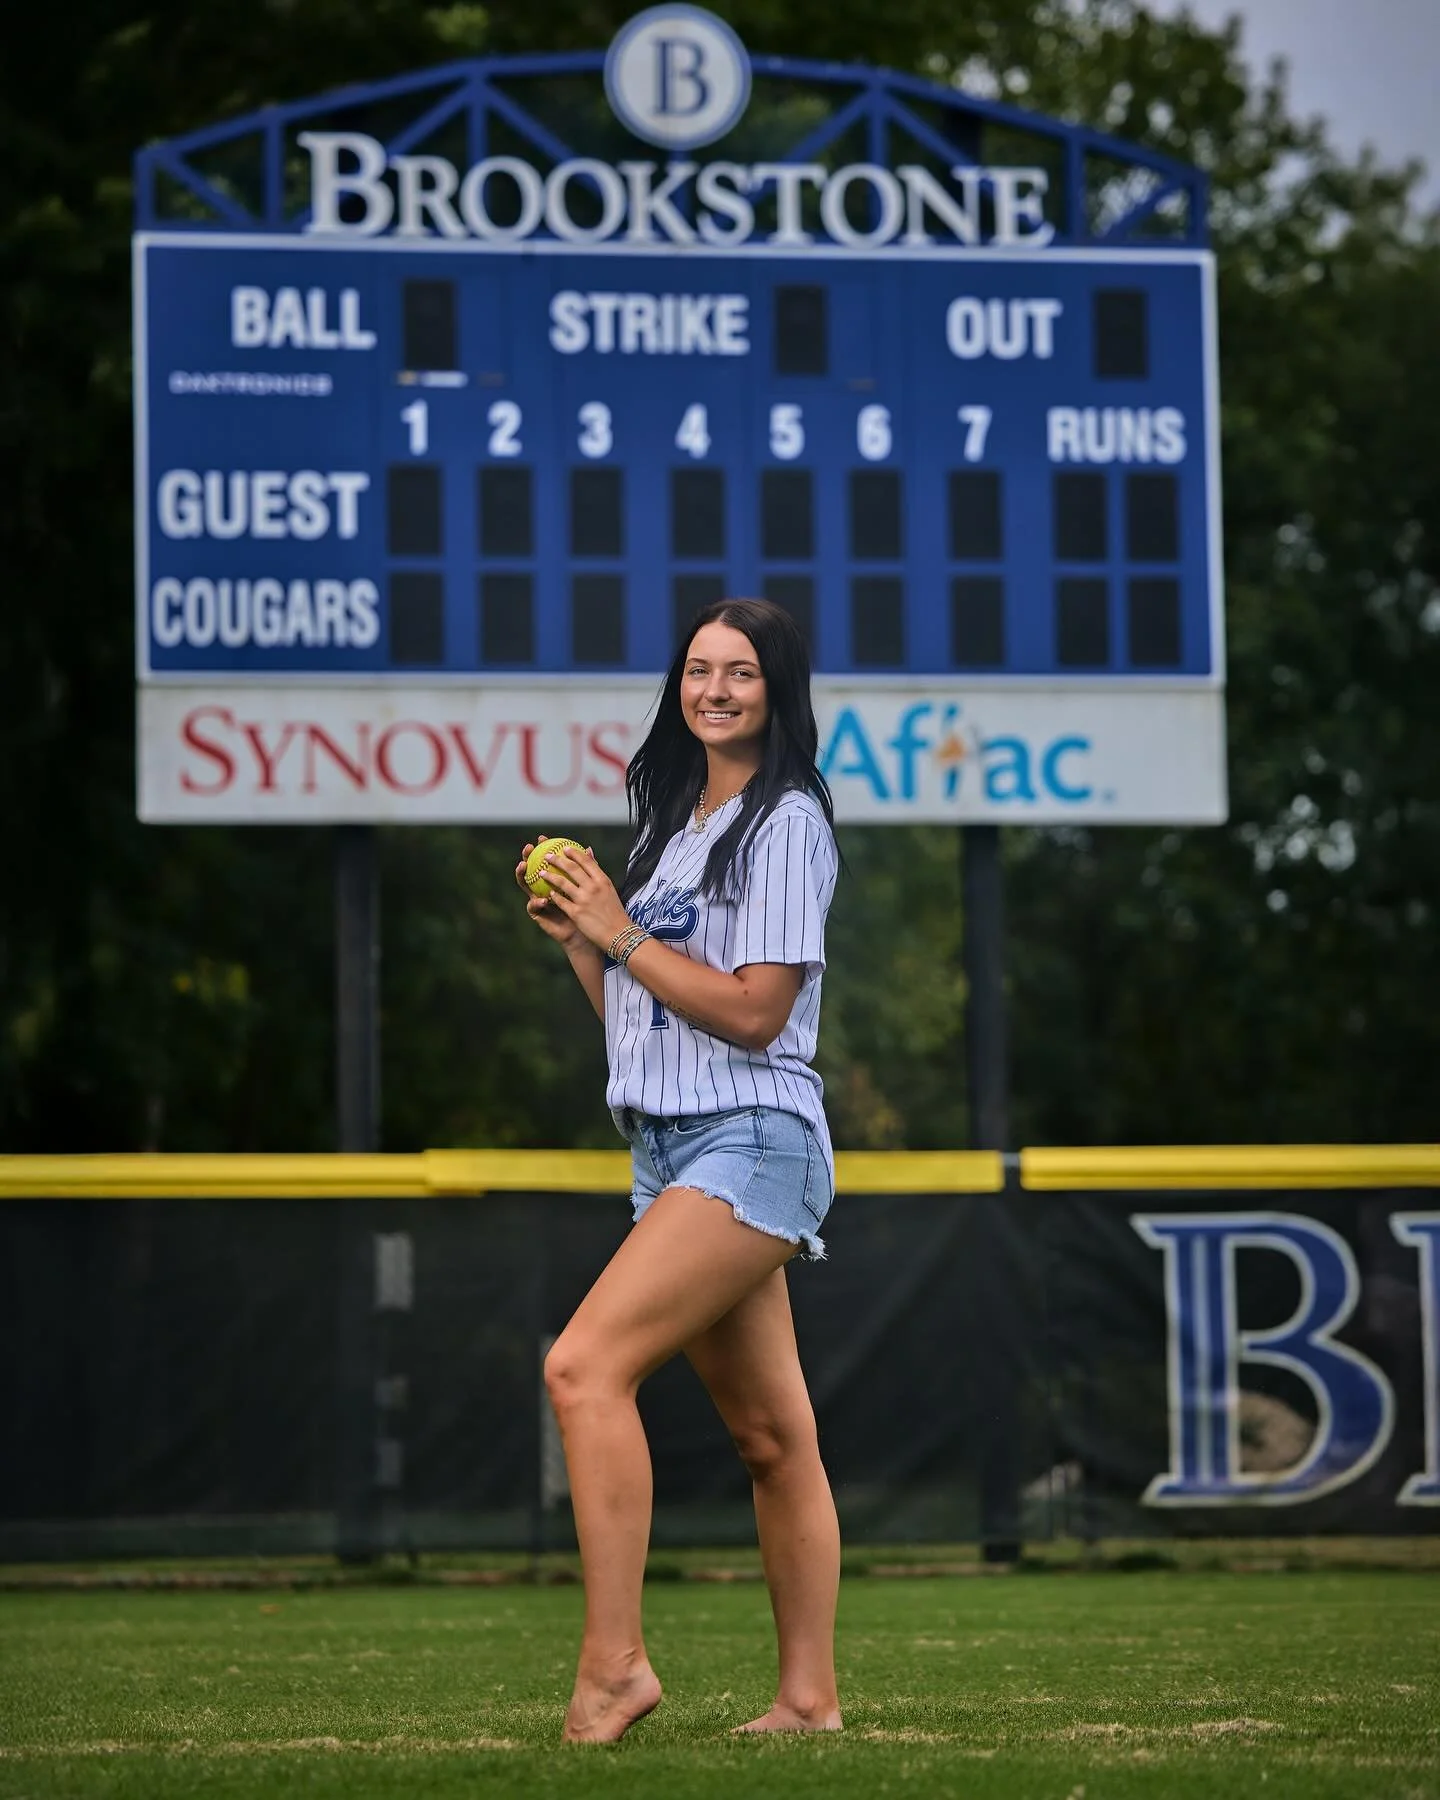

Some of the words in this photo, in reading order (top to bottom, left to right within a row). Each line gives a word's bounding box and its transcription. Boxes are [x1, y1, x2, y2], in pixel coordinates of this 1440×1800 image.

[652, 38, 709, 117] B
[231, 286, 376, 349] BALL
[550, 292, 749, 354] STRIKE
[947, 298, 1061, 360] OUT
[401, 400, 428, 455] 1
[488, 401, 522, 457] 2
[578, 402, 613, 458] 3
[675, 404, 711, 458] 4
[769, 404, 804, 459] 5
[856, 405, 892, 460] 6
[958, 406, 991, 461] 7
[1048, 408, 1185, 463] RUNS
[158, 470, 369, 539] GUEST
[152, 578, 380, 648] COUGARS
[179, 706, 628, 796] SYNOVUS
